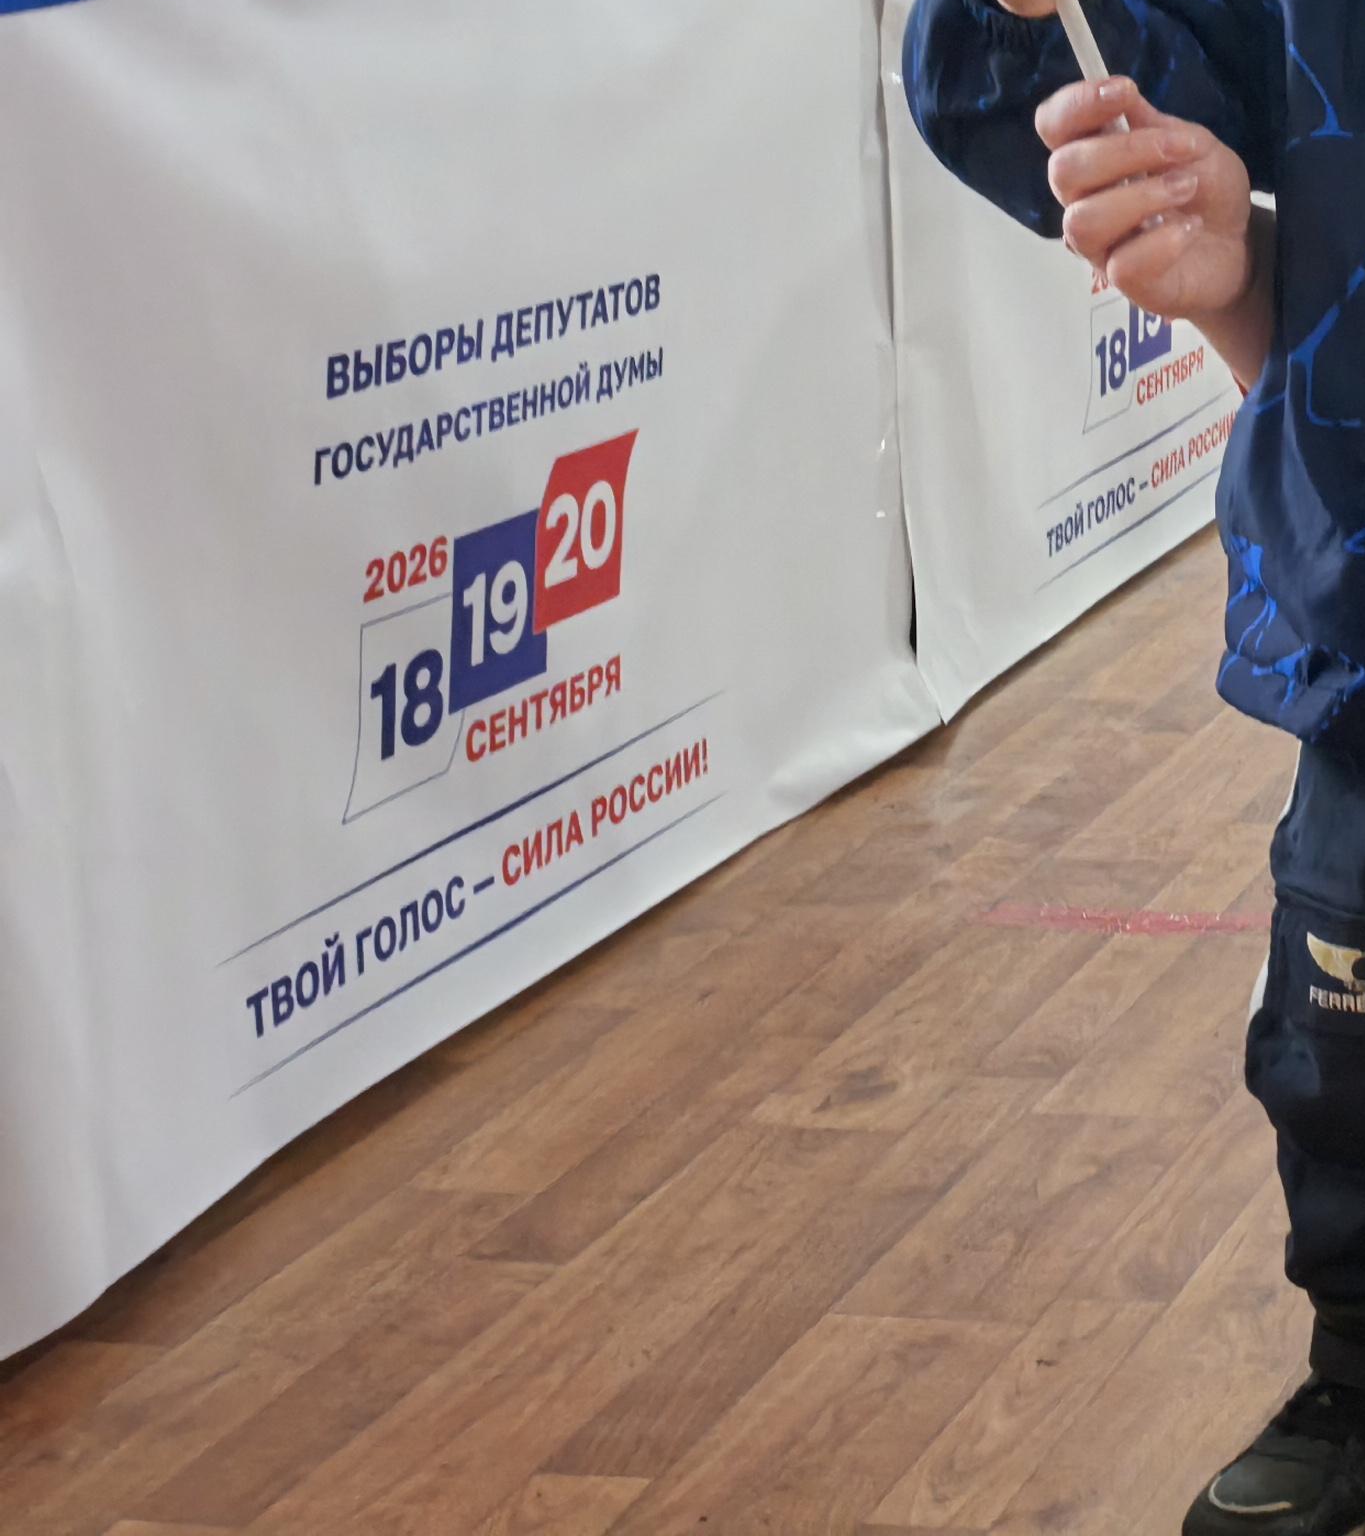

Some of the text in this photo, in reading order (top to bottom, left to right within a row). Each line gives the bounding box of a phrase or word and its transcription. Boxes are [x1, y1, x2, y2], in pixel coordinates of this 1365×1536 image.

[326, 273, 661, 399] ВЫБОРЫ ДЕПУТАТОВ
[1095, 328, 1127, 398] 18
[1136, 345, 1205, 406] СЕНТЯБРЯ
[313, 346, 664, 486] ГОСУДАРСТВЕННОЙ ДУМЫ
[1046, 500, 1084, 558] ТВОЙ
[1087, 477, 1136, 531] ГОЛОС
[1151, 445, 1186, 489] СИЛА
[362, 536, 449, 604] 2026
[369, 479, 616, 761] 18 19 20
[465, 653, 623, 763] СЕНТЯБРЯ
[246, 932, 346, 1038] ТВОЙ
[354, 875, 467, 976] ГОЛОС
[501, 810, 584, 888] СИЛА
[590, 737, 709, 838] РОССИИ!
